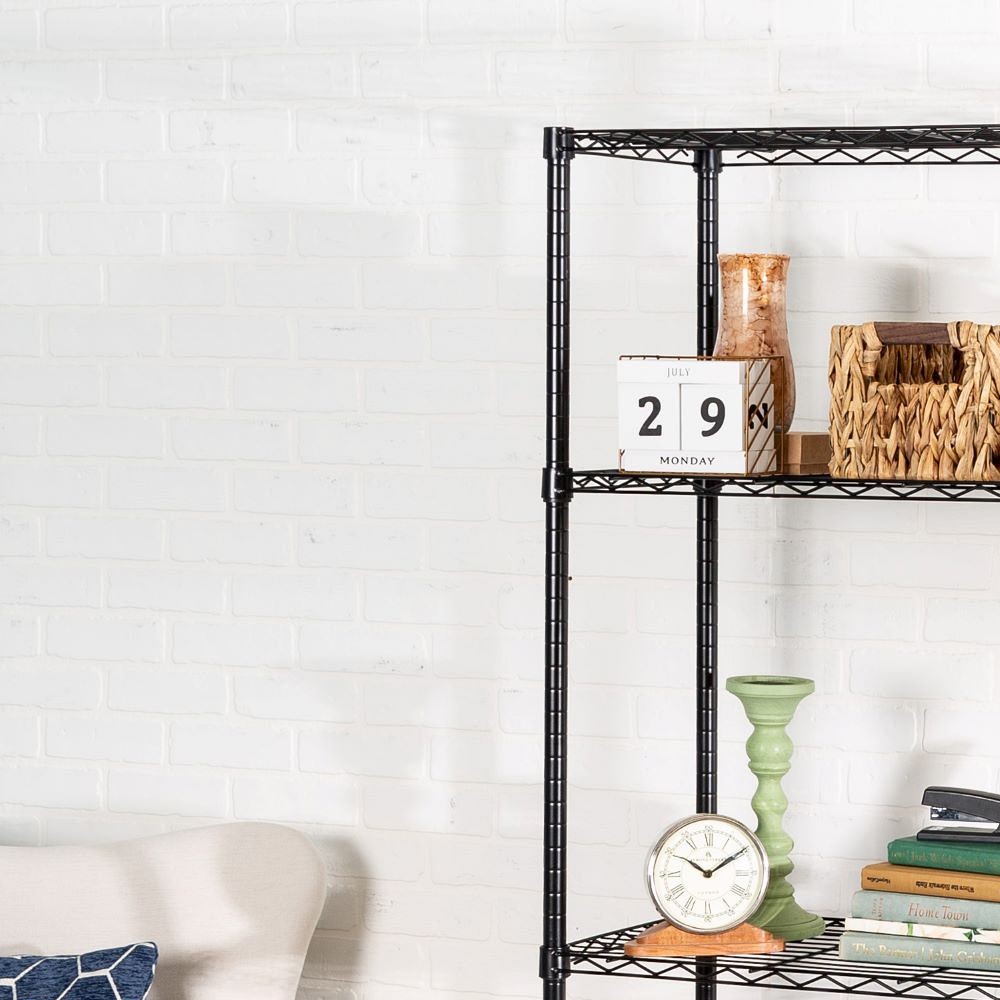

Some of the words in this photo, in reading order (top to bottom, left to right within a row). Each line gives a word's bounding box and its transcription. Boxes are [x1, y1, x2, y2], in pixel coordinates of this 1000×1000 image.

[666, 367, 691, 378] JULY
[638, 395, 662, 436] 2
[700, 396, 726, 437] 9
[660, 456, 715, 466] MONDAY
[907, 902, 940, 919] Home
[942, 904, 969, 921] Town
[852, 942, 876, 957] The
[927, 947, 953, 961] John
